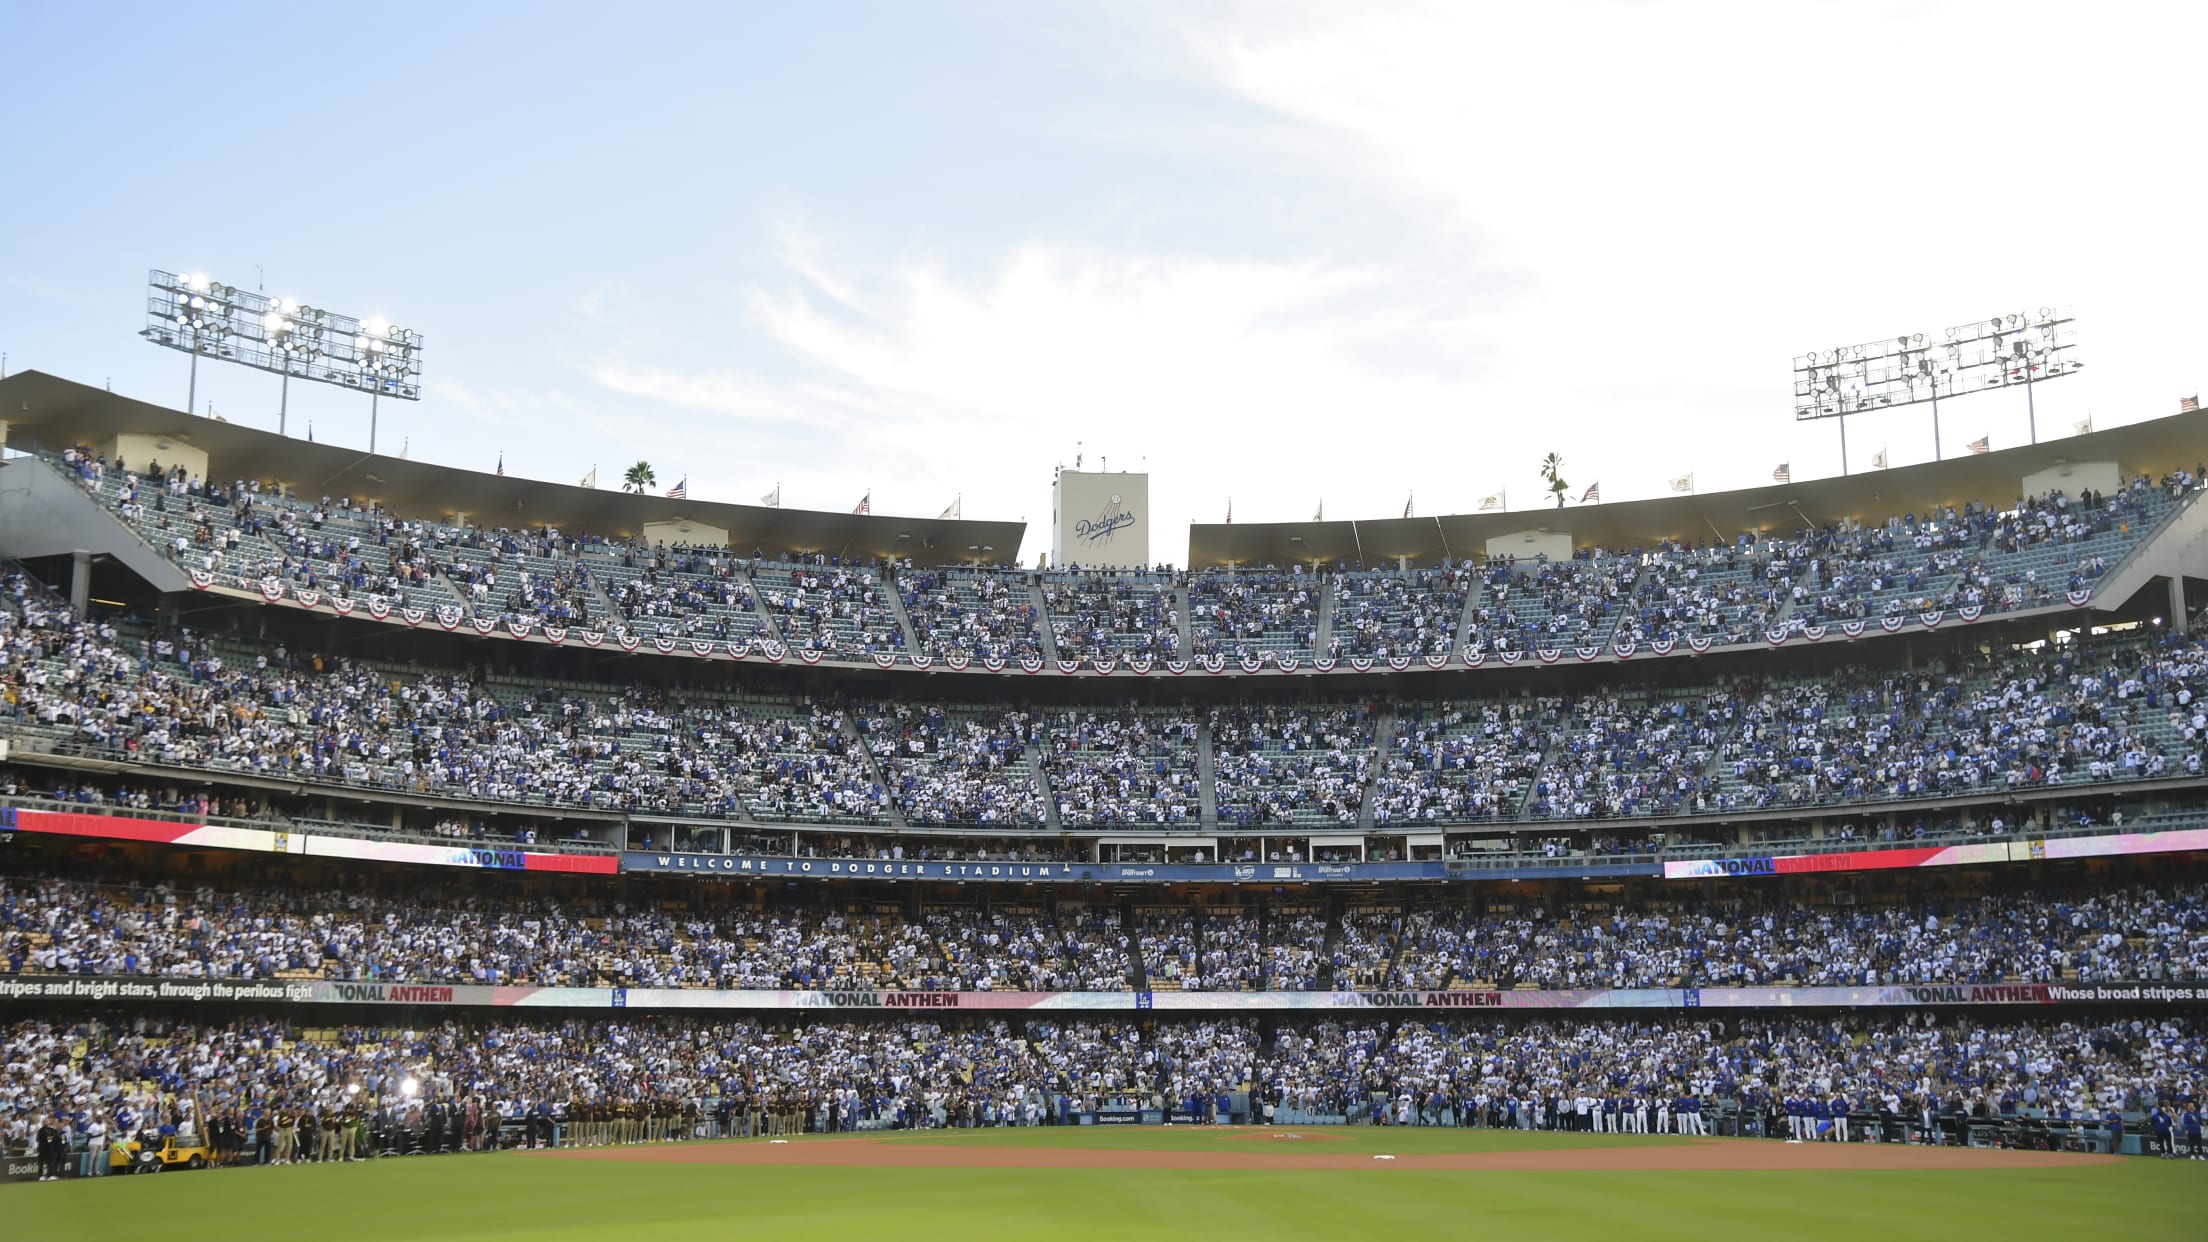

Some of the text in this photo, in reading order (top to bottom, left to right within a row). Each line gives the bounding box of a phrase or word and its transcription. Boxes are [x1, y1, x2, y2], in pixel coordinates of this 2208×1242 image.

[1075, 511, 1135, 540] Dodgers
[658, 856, 1049, 877] WELCOME TO DODGER STADIUM
[44, 980, 75, 995] and
[75, 980, 118, 999] bright
[119, 982, 158, 999] stars,
[159, 982, 211, 1000] through
[212, 983, 234, 997] the
[234, 984, 284, 1000] perilous
[285, 984, 313, 1001] fight
[388, 985, 453, 1002] ANTHEM
[1879, 987, 2050, 1002] NATIONAL ANTHEM
[2048, 986, 2095, 1000] Whose
[2097, 986, 2140, 1000] broad
[2142, 986, 2193, 1002] stripes
[795, 993, 959, 1007] NATIONAL ANTHEM
[1332, 993, 1502, 1006] NATIONAL ANTHEM
[1100, 1115, 1135, 1123] Booking.com
